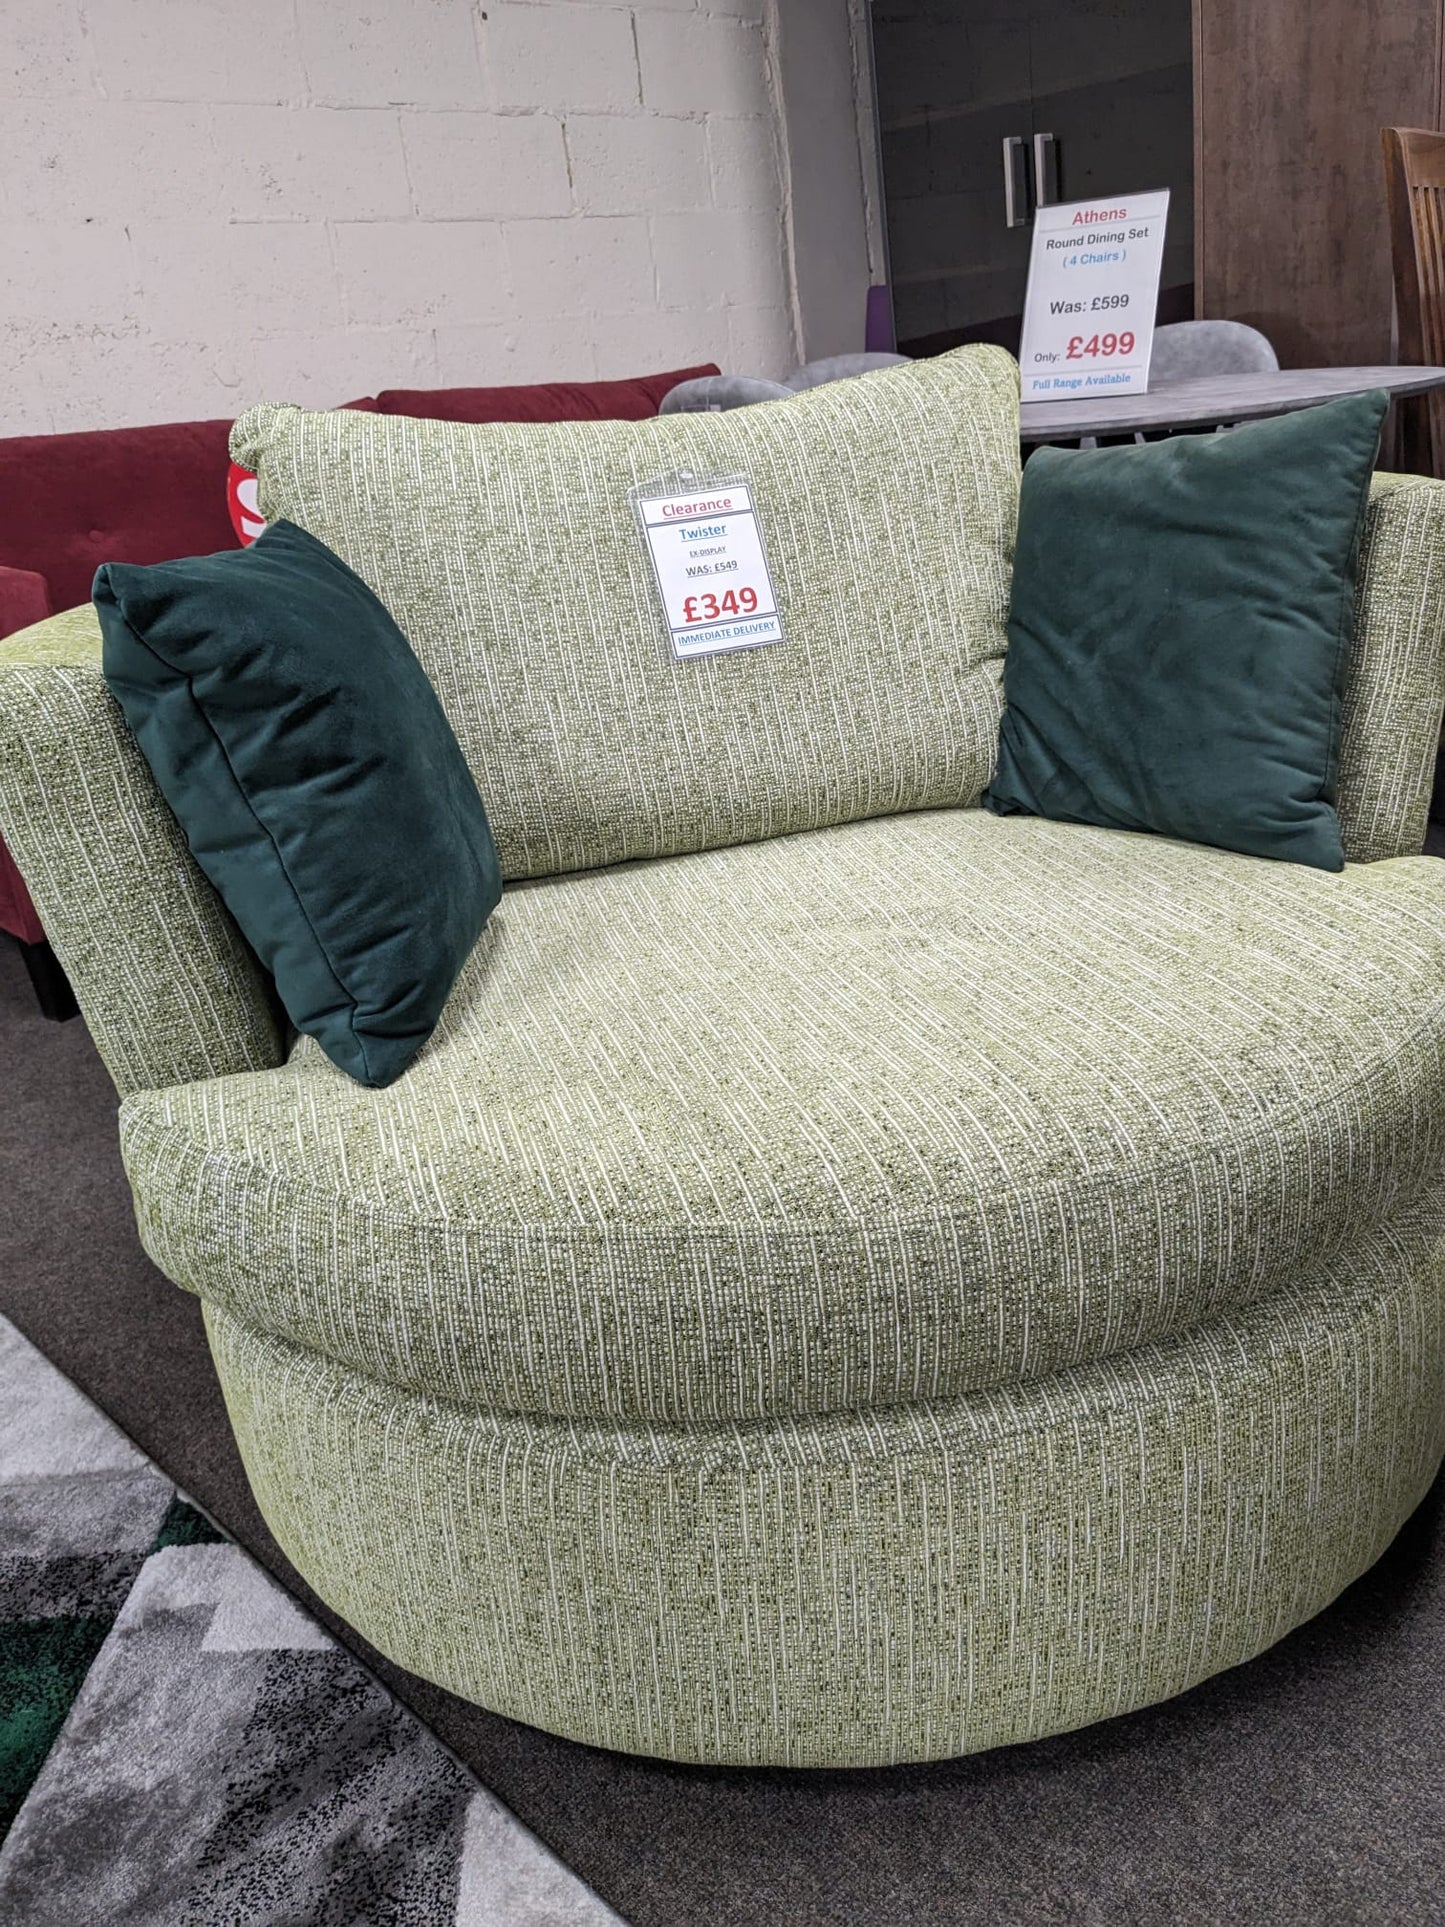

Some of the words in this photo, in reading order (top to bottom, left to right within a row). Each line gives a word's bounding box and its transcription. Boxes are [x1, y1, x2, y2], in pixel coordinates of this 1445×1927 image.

[1072, 208, 1127, 225] Athens
[1046, 234, 1083, 250] Round
[1087, 230, 1125, 245] Dining
[1129, 227, 1148, 239] Set
[1050, 301, 1086, 314] Was:
[1091, 294, 1129, 311] £599
[1034, 353, 1060, 363] Only:
[1066, 332, 1135, 360] £499
[1032, 379, 1050, 390] Full
[1053, 376, 1082, 388] Range
[1085, 373, 1130, 385] Available
[662, 498, 733, 520] Clearance
[679, 525, 728, 542] Twister
[690, 546, 726, 558] EX-DISPLAY
[686, 565, 712, 578] WAS:
[714, 560, 738, 573] £549
[683, 587, 758, 623] £349
[678, 628, 731, 646] IMMEDIATE
[733, 621, 776, 637] DELIVERY
